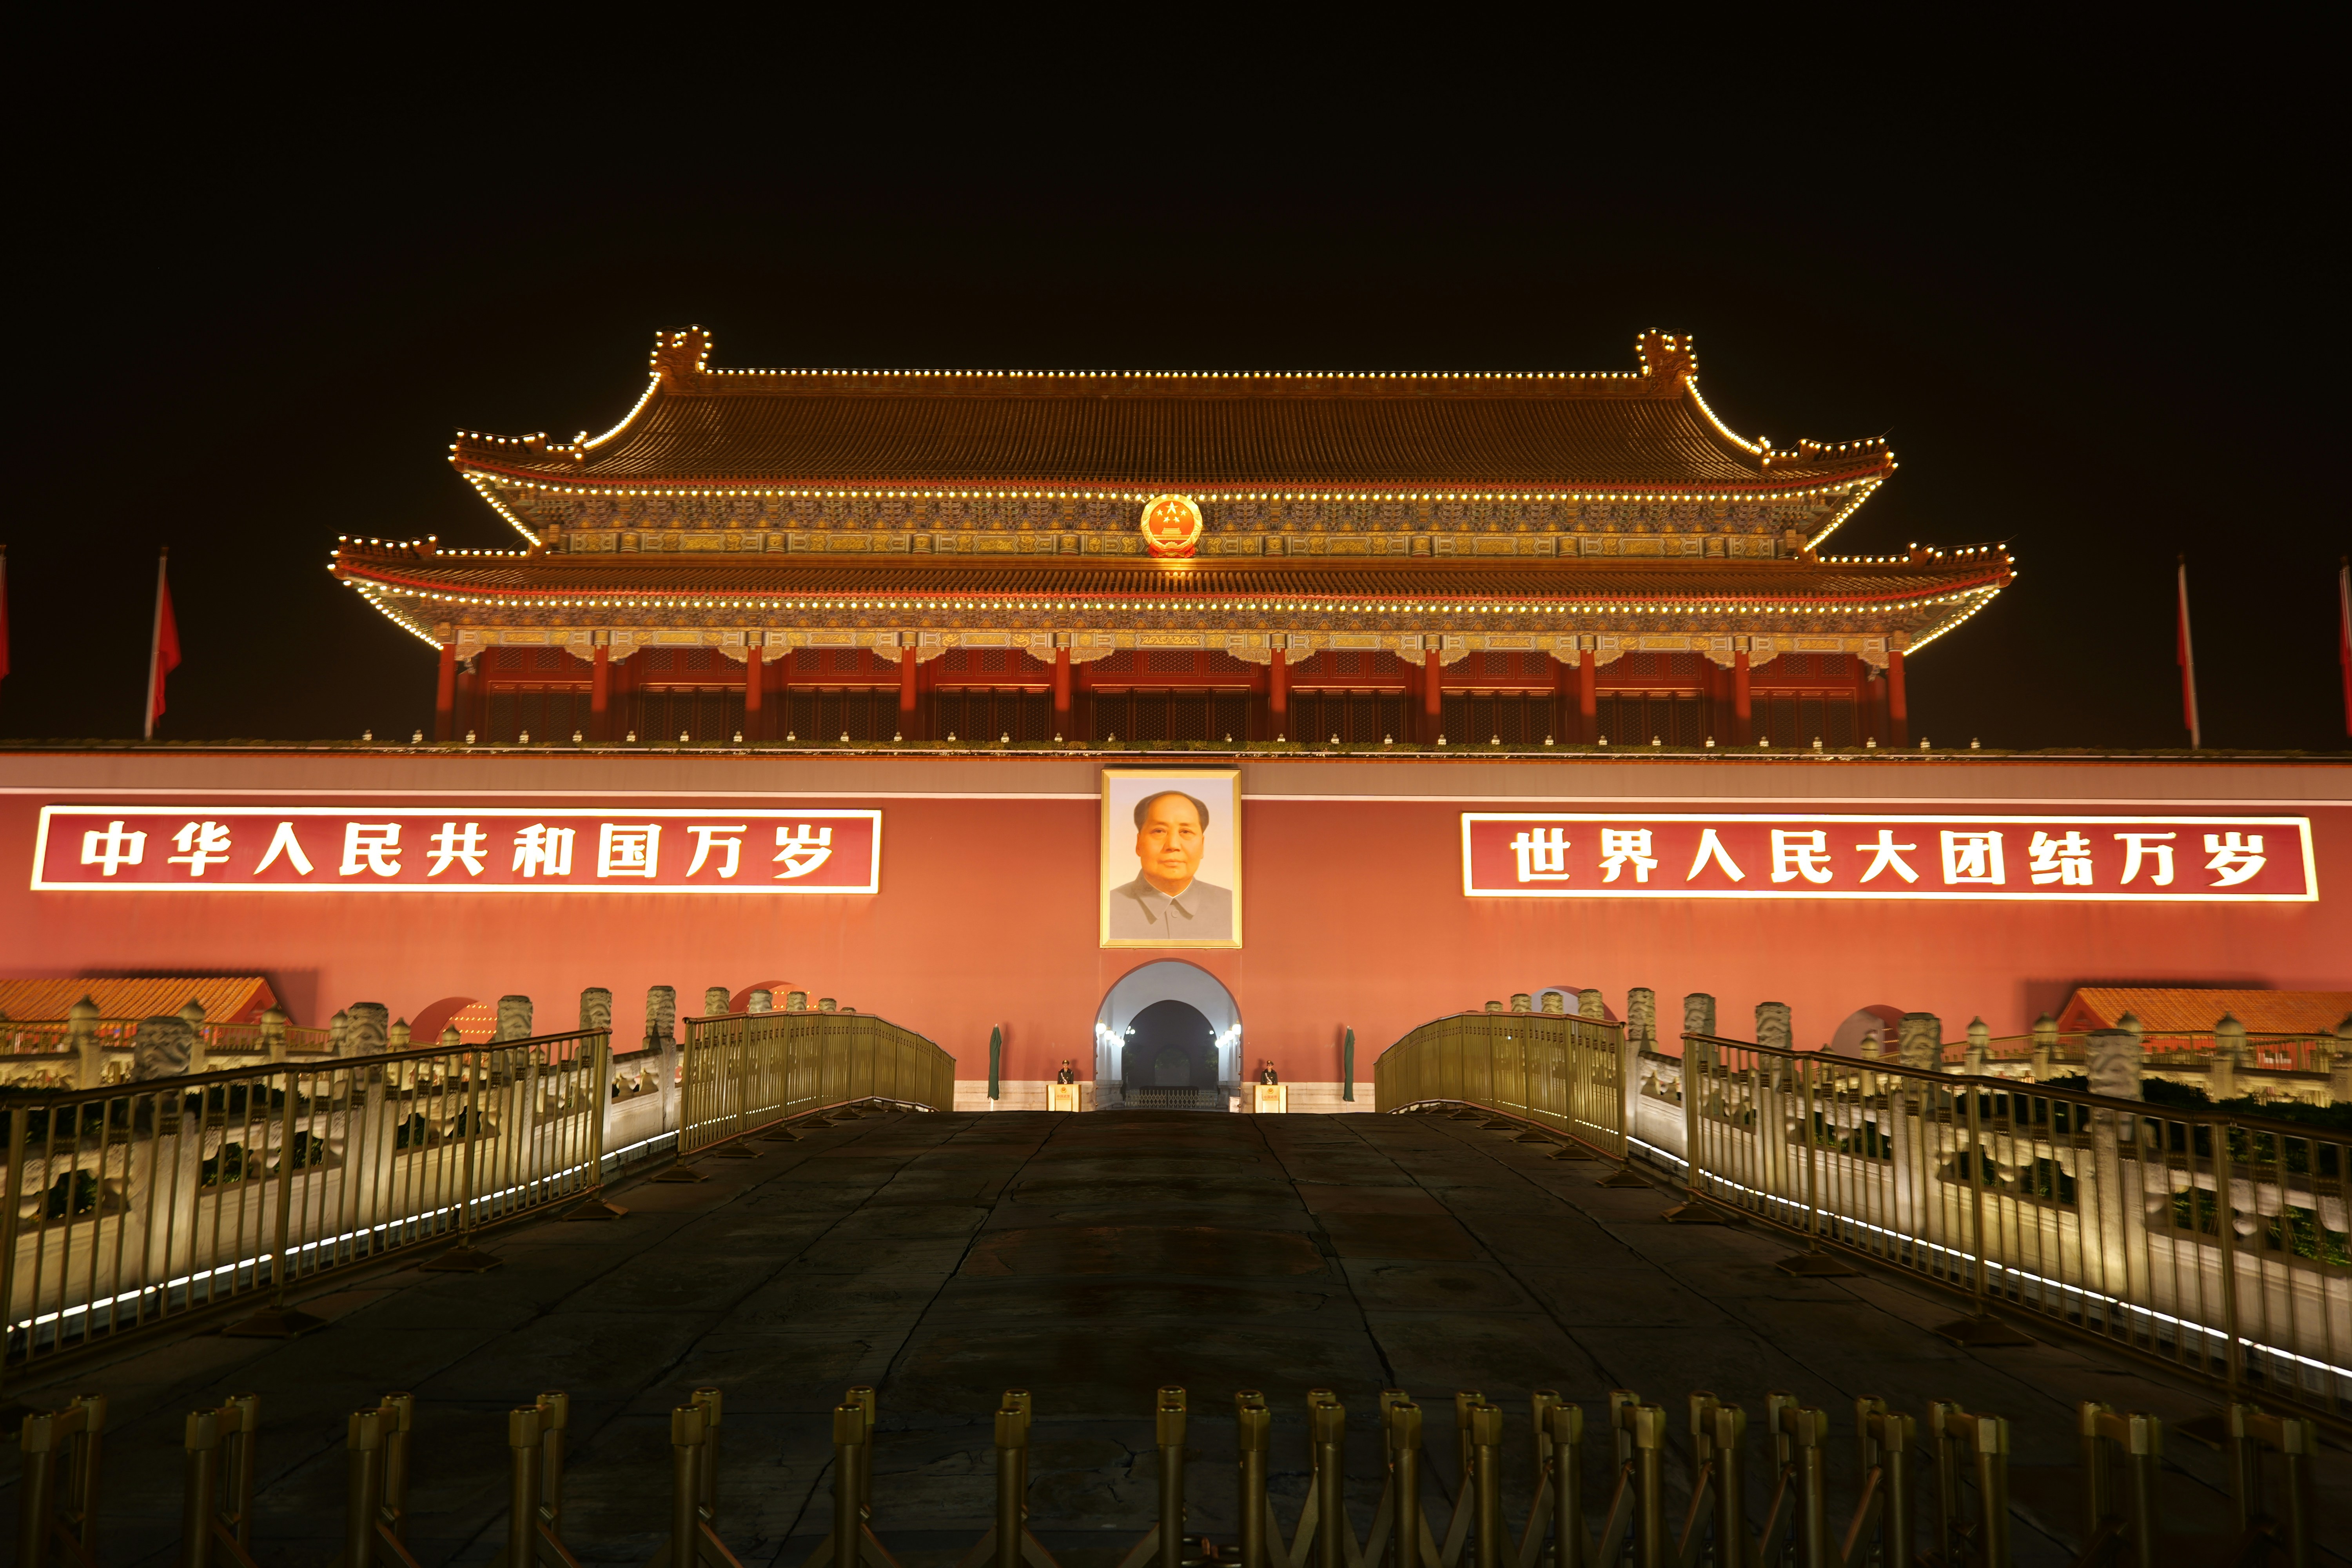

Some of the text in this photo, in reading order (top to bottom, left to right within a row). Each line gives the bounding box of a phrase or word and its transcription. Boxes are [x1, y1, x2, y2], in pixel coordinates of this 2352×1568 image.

[82, 821, 833, 878] 中华人民共和国万岁
[1510, 828, 2267, 887] 世界人民大团结万岁
